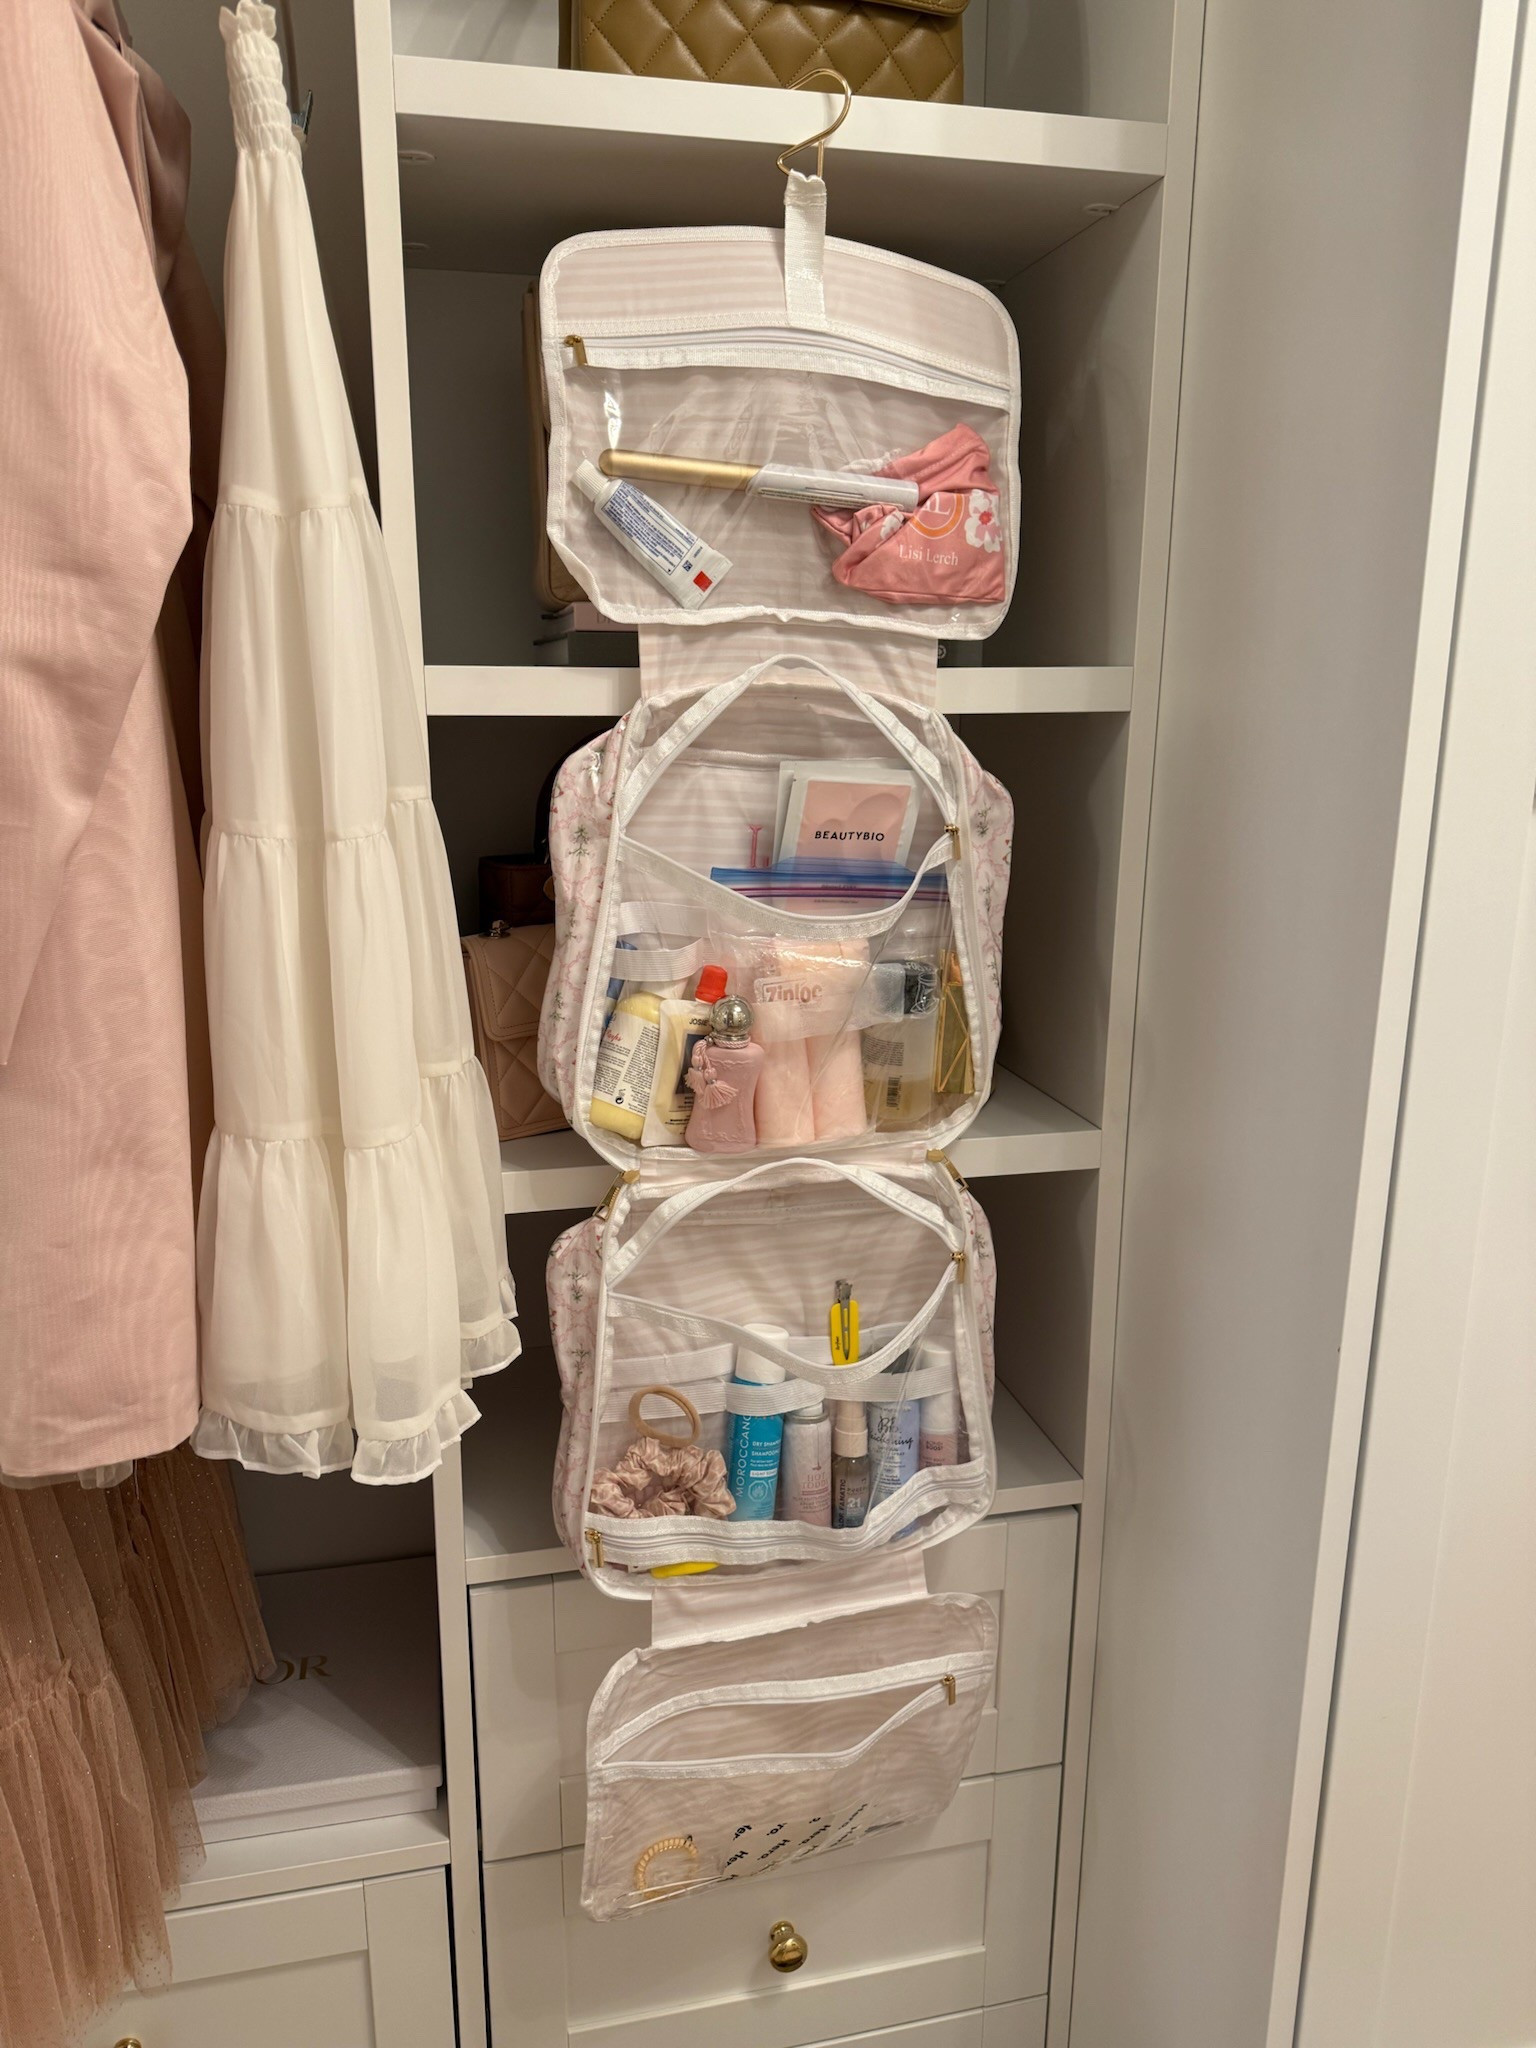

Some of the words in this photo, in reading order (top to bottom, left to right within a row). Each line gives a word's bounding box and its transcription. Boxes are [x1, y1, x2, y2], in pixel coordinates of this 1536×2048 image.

[898, 544, 924, 561] Lisi
[925, 547, 960, 567] Lerch
[813, 829, 886, 843] BEAUTYBIO
[806, 1471, 826, 1482] HOT
[847, 1497, 862, 1508] 21
